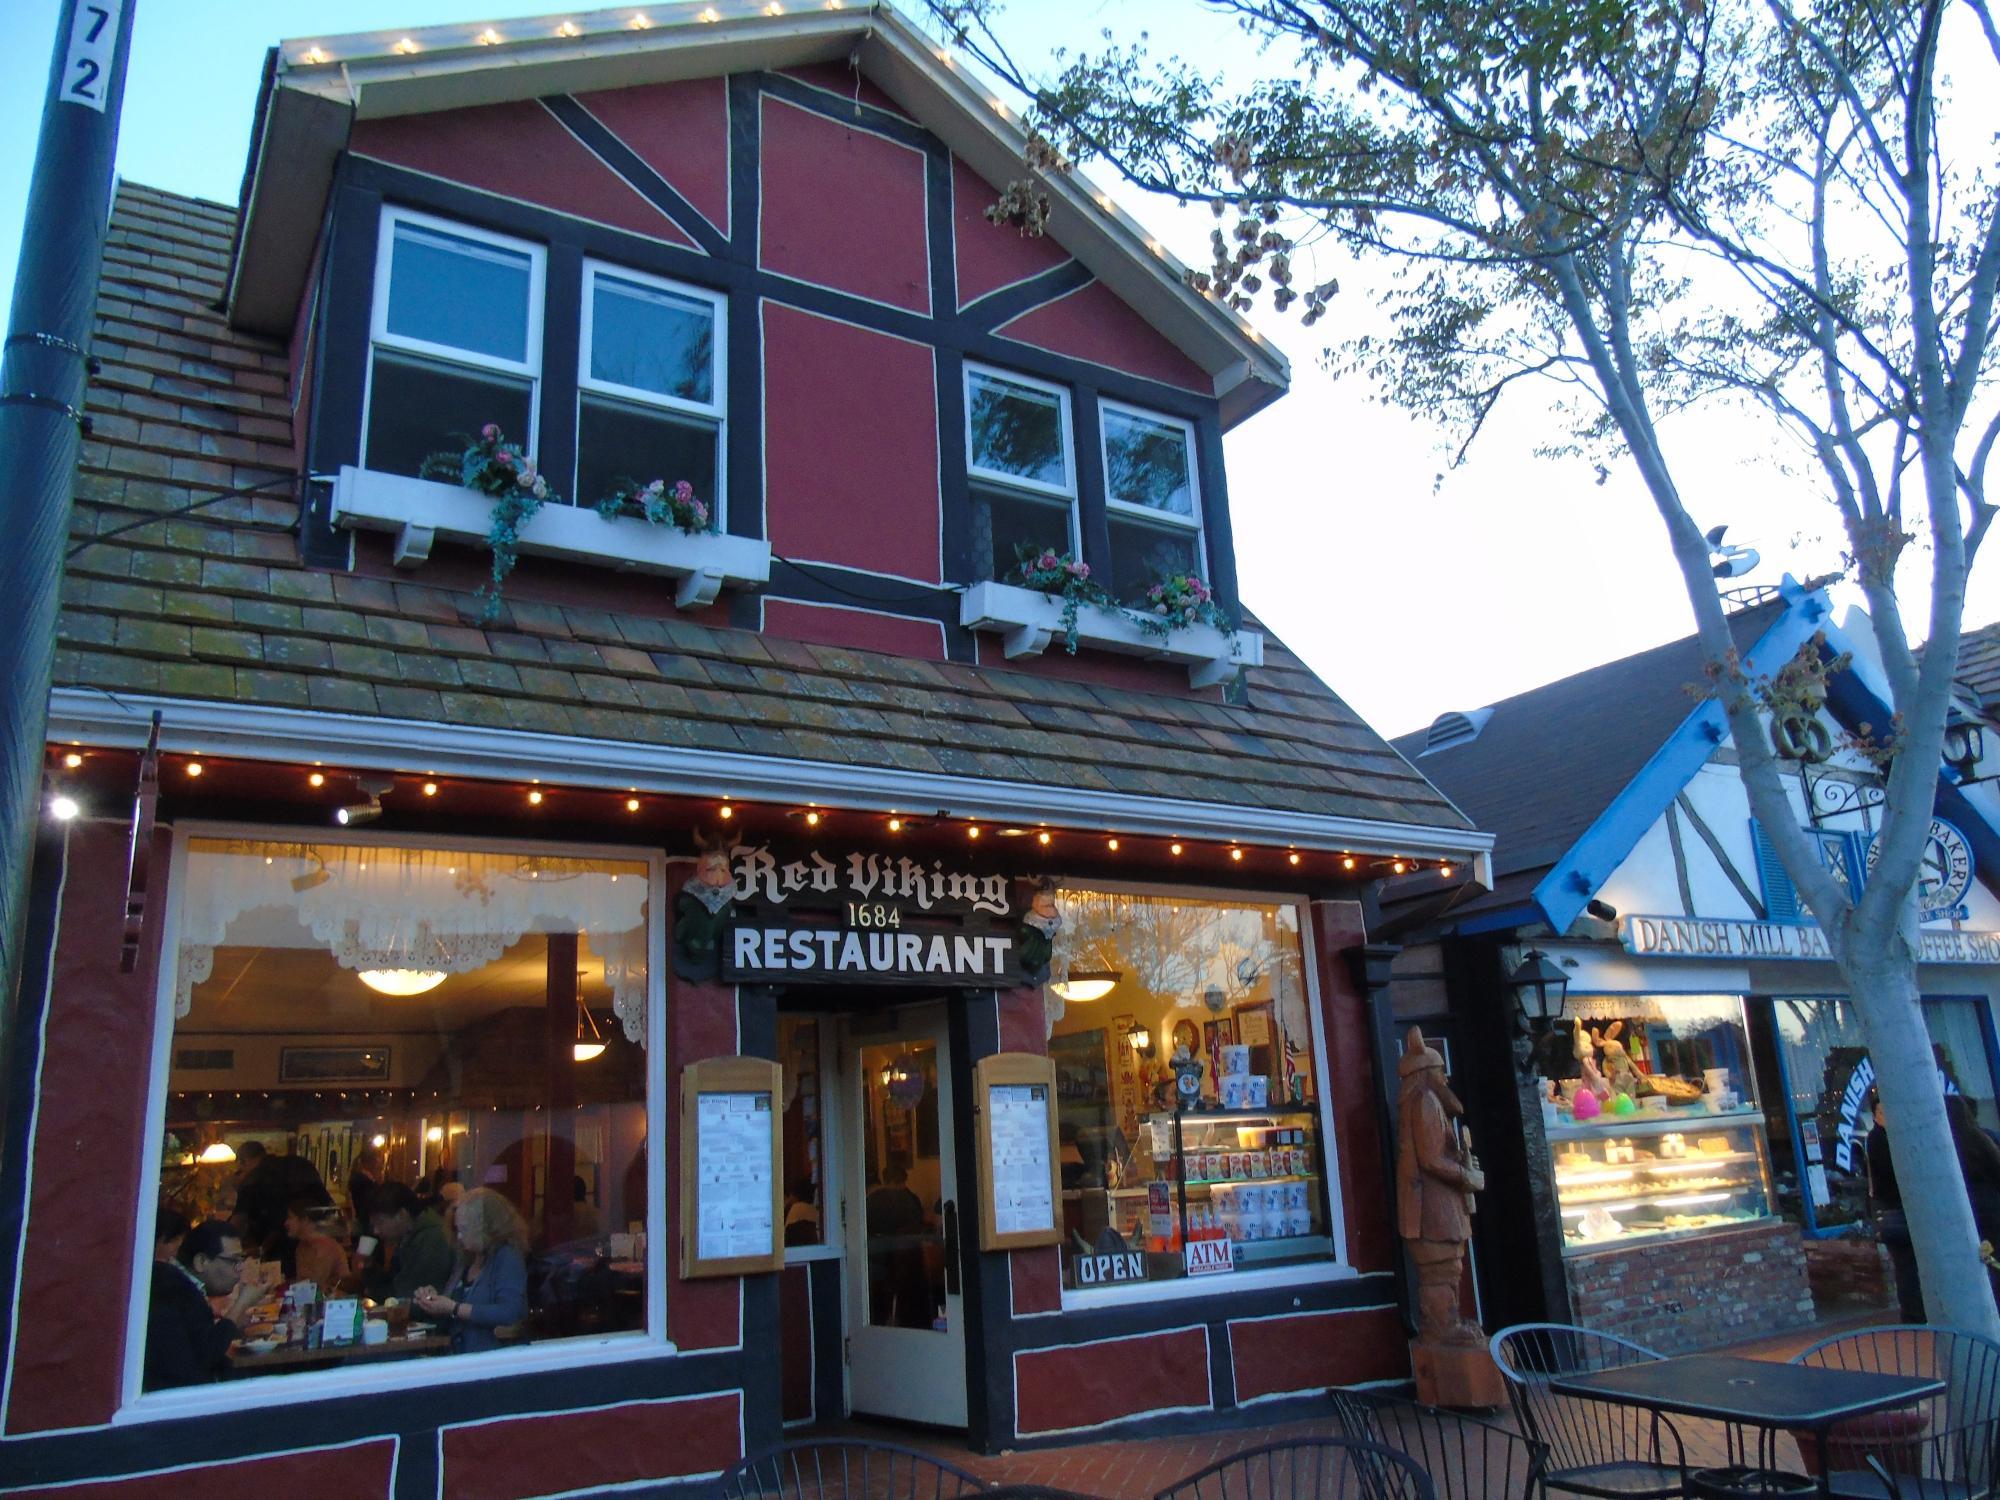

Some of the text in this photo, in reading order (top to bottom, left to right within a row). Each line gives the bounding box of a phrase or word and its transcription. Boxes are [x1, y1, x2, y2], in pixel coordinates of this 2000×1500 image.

[1929, 821, 1968, 895] BAKERY
[730, 845, 1010, 916] Red Viking
[849, 902, 901, 929] 1684
[733, 927, 1012, 974] RESTAURANT
[1638, 919, 1732, 955] DANISH
[1735, 923, 1793, 957] MILL
[1918, 934, 1966, 961] FFEE
[1966, 934, 2000, 961] SHO
[1835, 1055, 1876, 1172] DANISH
[1080, 1252, 1143, 1283] OPEN
[1191, 1241, 1230, 1265] ATM
